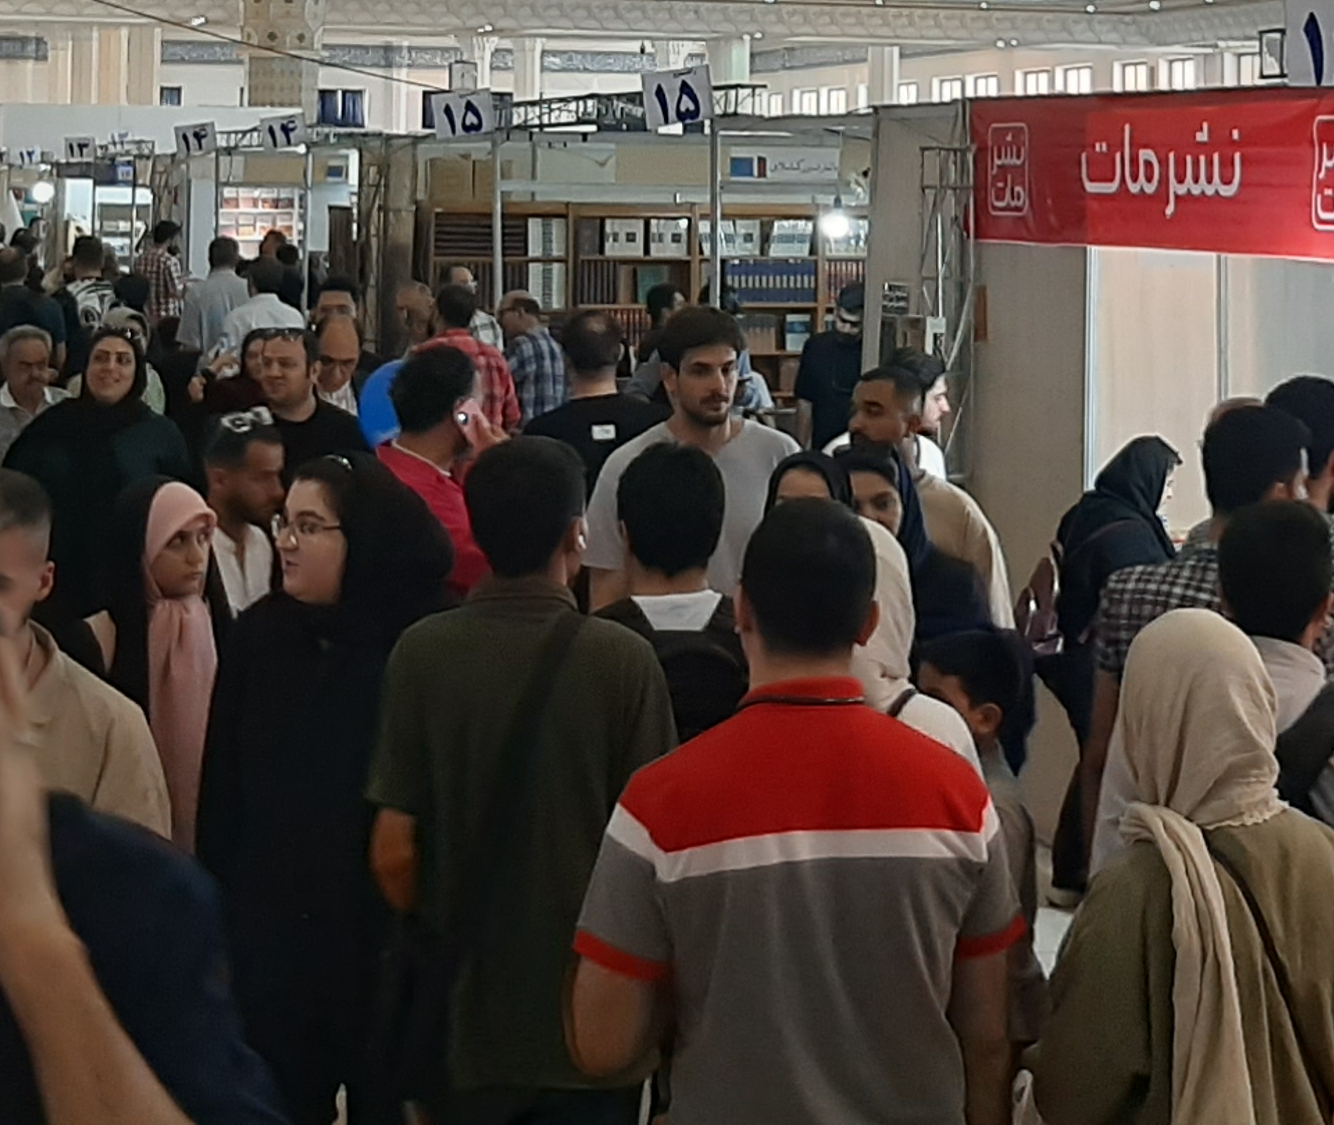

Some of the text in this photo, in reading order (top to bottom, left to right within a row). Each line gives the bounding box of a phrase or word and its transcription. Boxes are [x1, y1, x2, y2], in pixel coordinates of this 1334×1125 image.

[443, 99, 483, 135] ۱۵
[654, 79, 701, 126] ۱۵
[182, 127, 208, 152] ۱۴
[268, 120, 298, 148] ۱۴
[991, 131, 1025, 175] نشر
[1081, 121, 1241, 218] نشر مات
[991, 174, 1025, 207] مات
